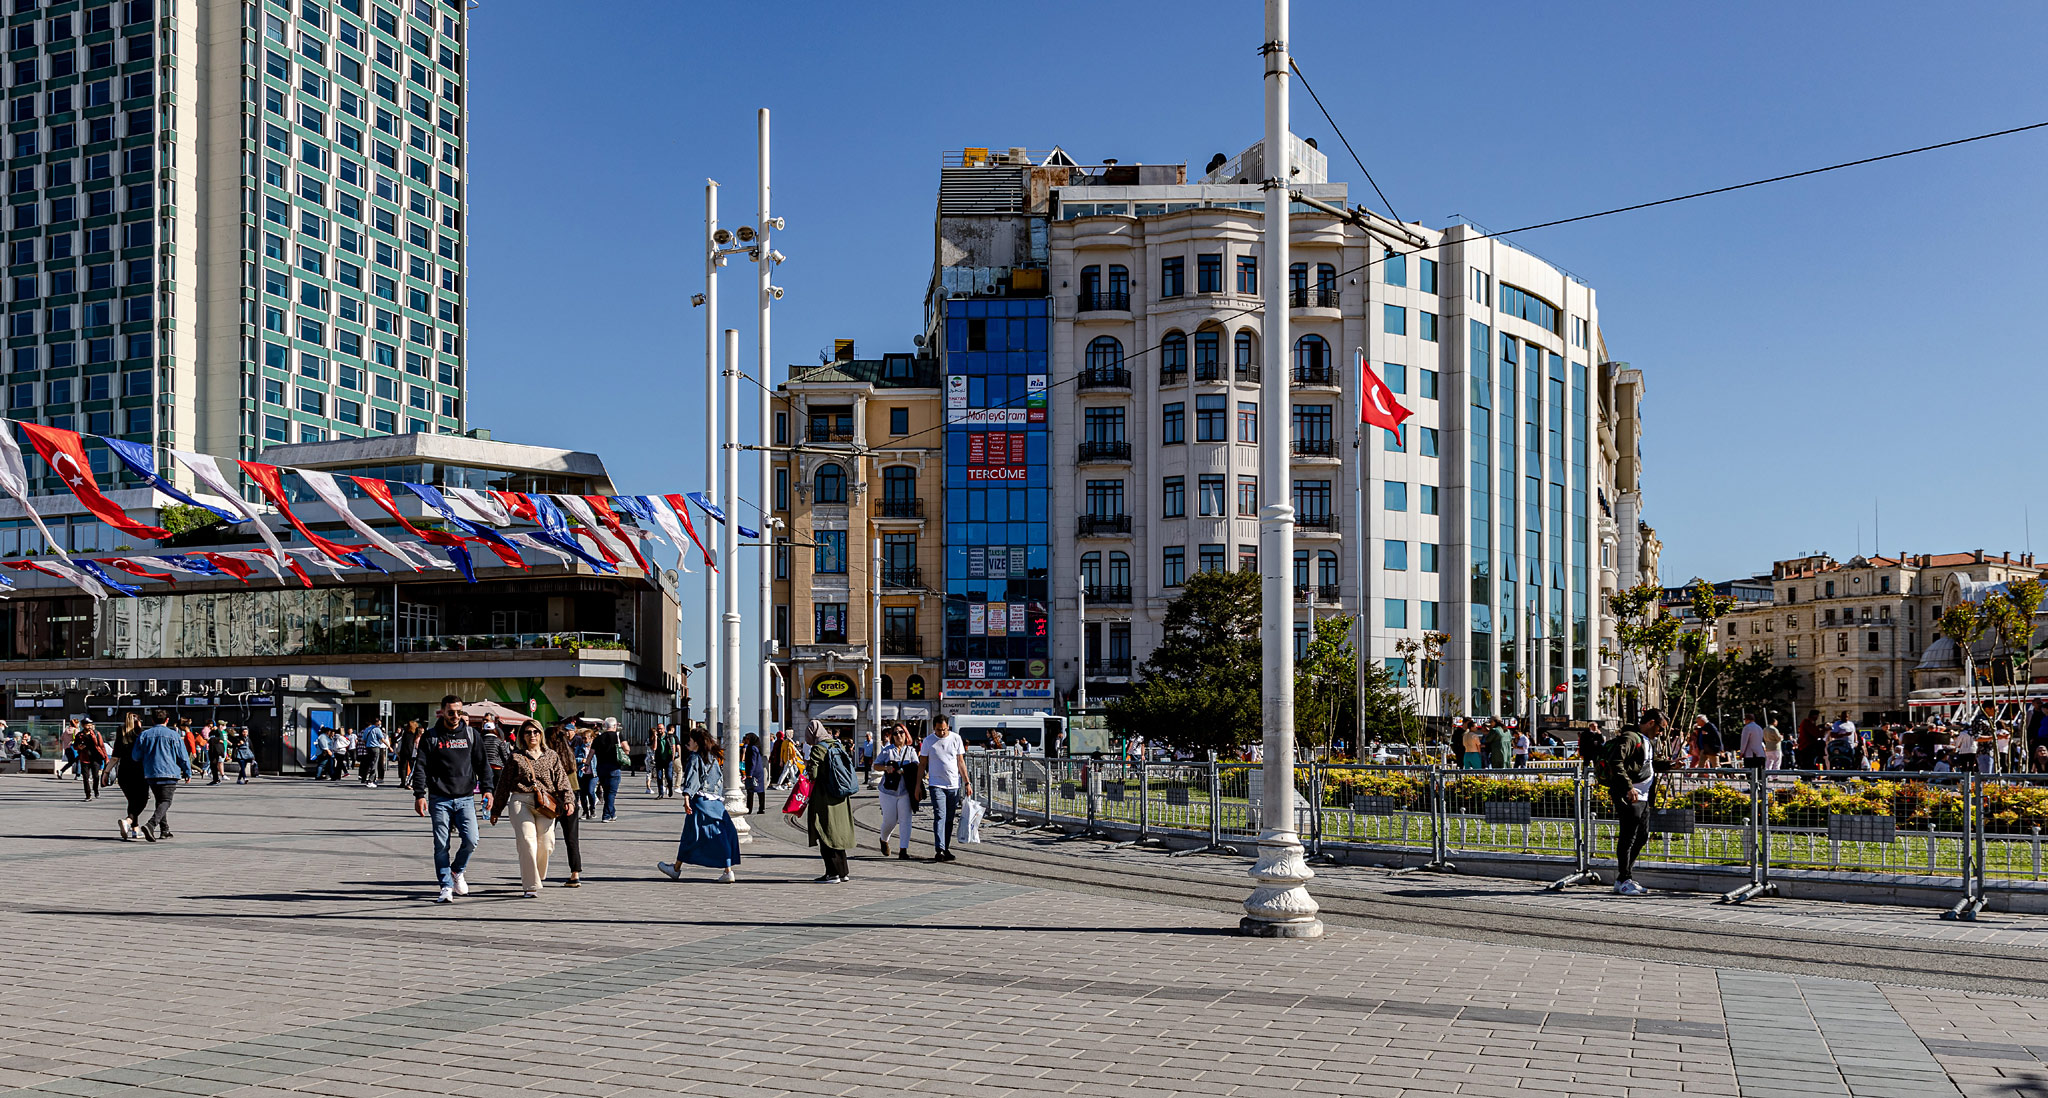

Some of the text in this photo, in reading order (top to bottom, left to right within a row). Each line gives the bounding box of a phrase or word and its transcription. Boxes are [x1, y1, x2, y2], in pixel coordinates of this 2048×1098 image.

[1031, 378, 1044, 387] Ria
[968, 410, 1026, 423] MoneyGram
[968, 467, 1026, 479] TERCÜME
[820, 682, 846, 692] gratis
[946, 680, 1050, 689] HOP ON HOP OFF
[970, 701, 1001, 709] CHANGE
